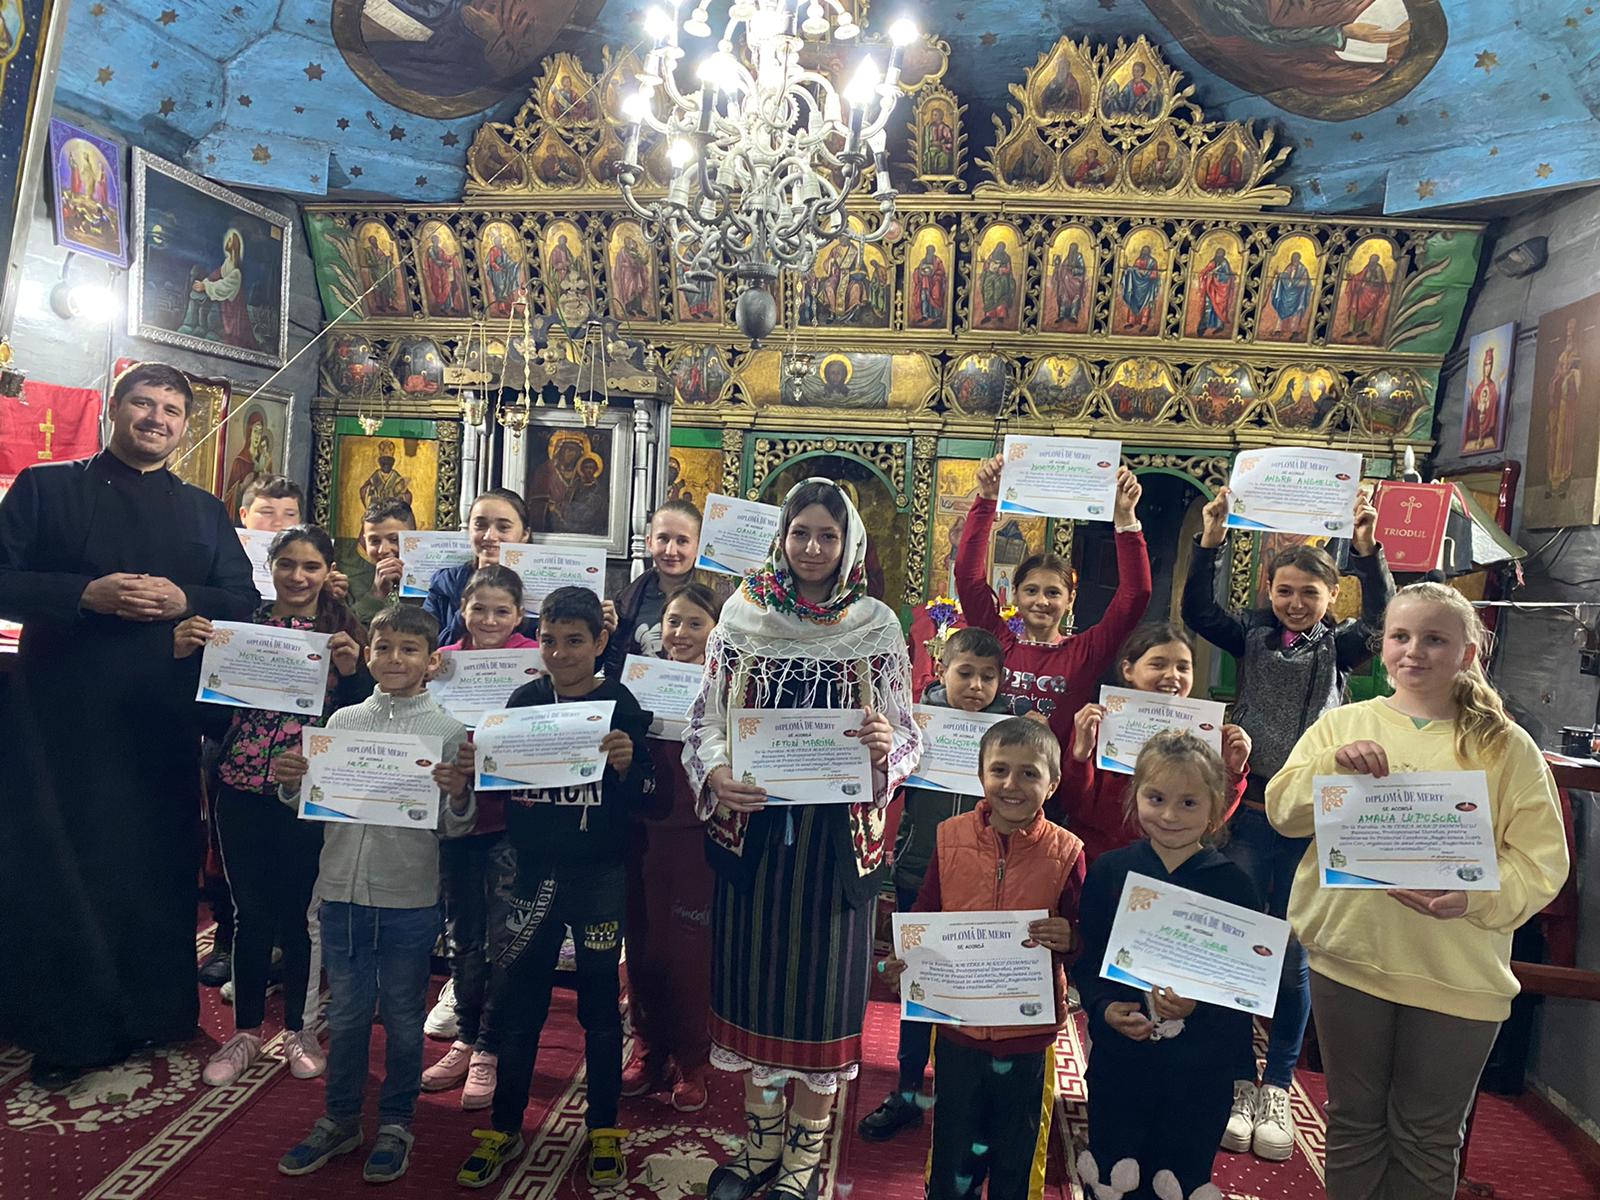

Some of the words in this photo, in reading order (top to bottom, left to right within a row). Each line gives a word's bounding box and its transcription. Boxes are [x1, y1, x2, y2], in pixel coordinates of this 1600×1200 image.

[1384, 528, 1426, 538] TRIODUL
[804, 722, 814, 730] DE
[1404, 791, 1416, 802] DE
[1416, 792, 1444, 802] MERIT
[1358, 814, 1396, 824] AMALIA
[976, 928, 988, 940] DE
[988, 930, 1012, 939] MERIT
